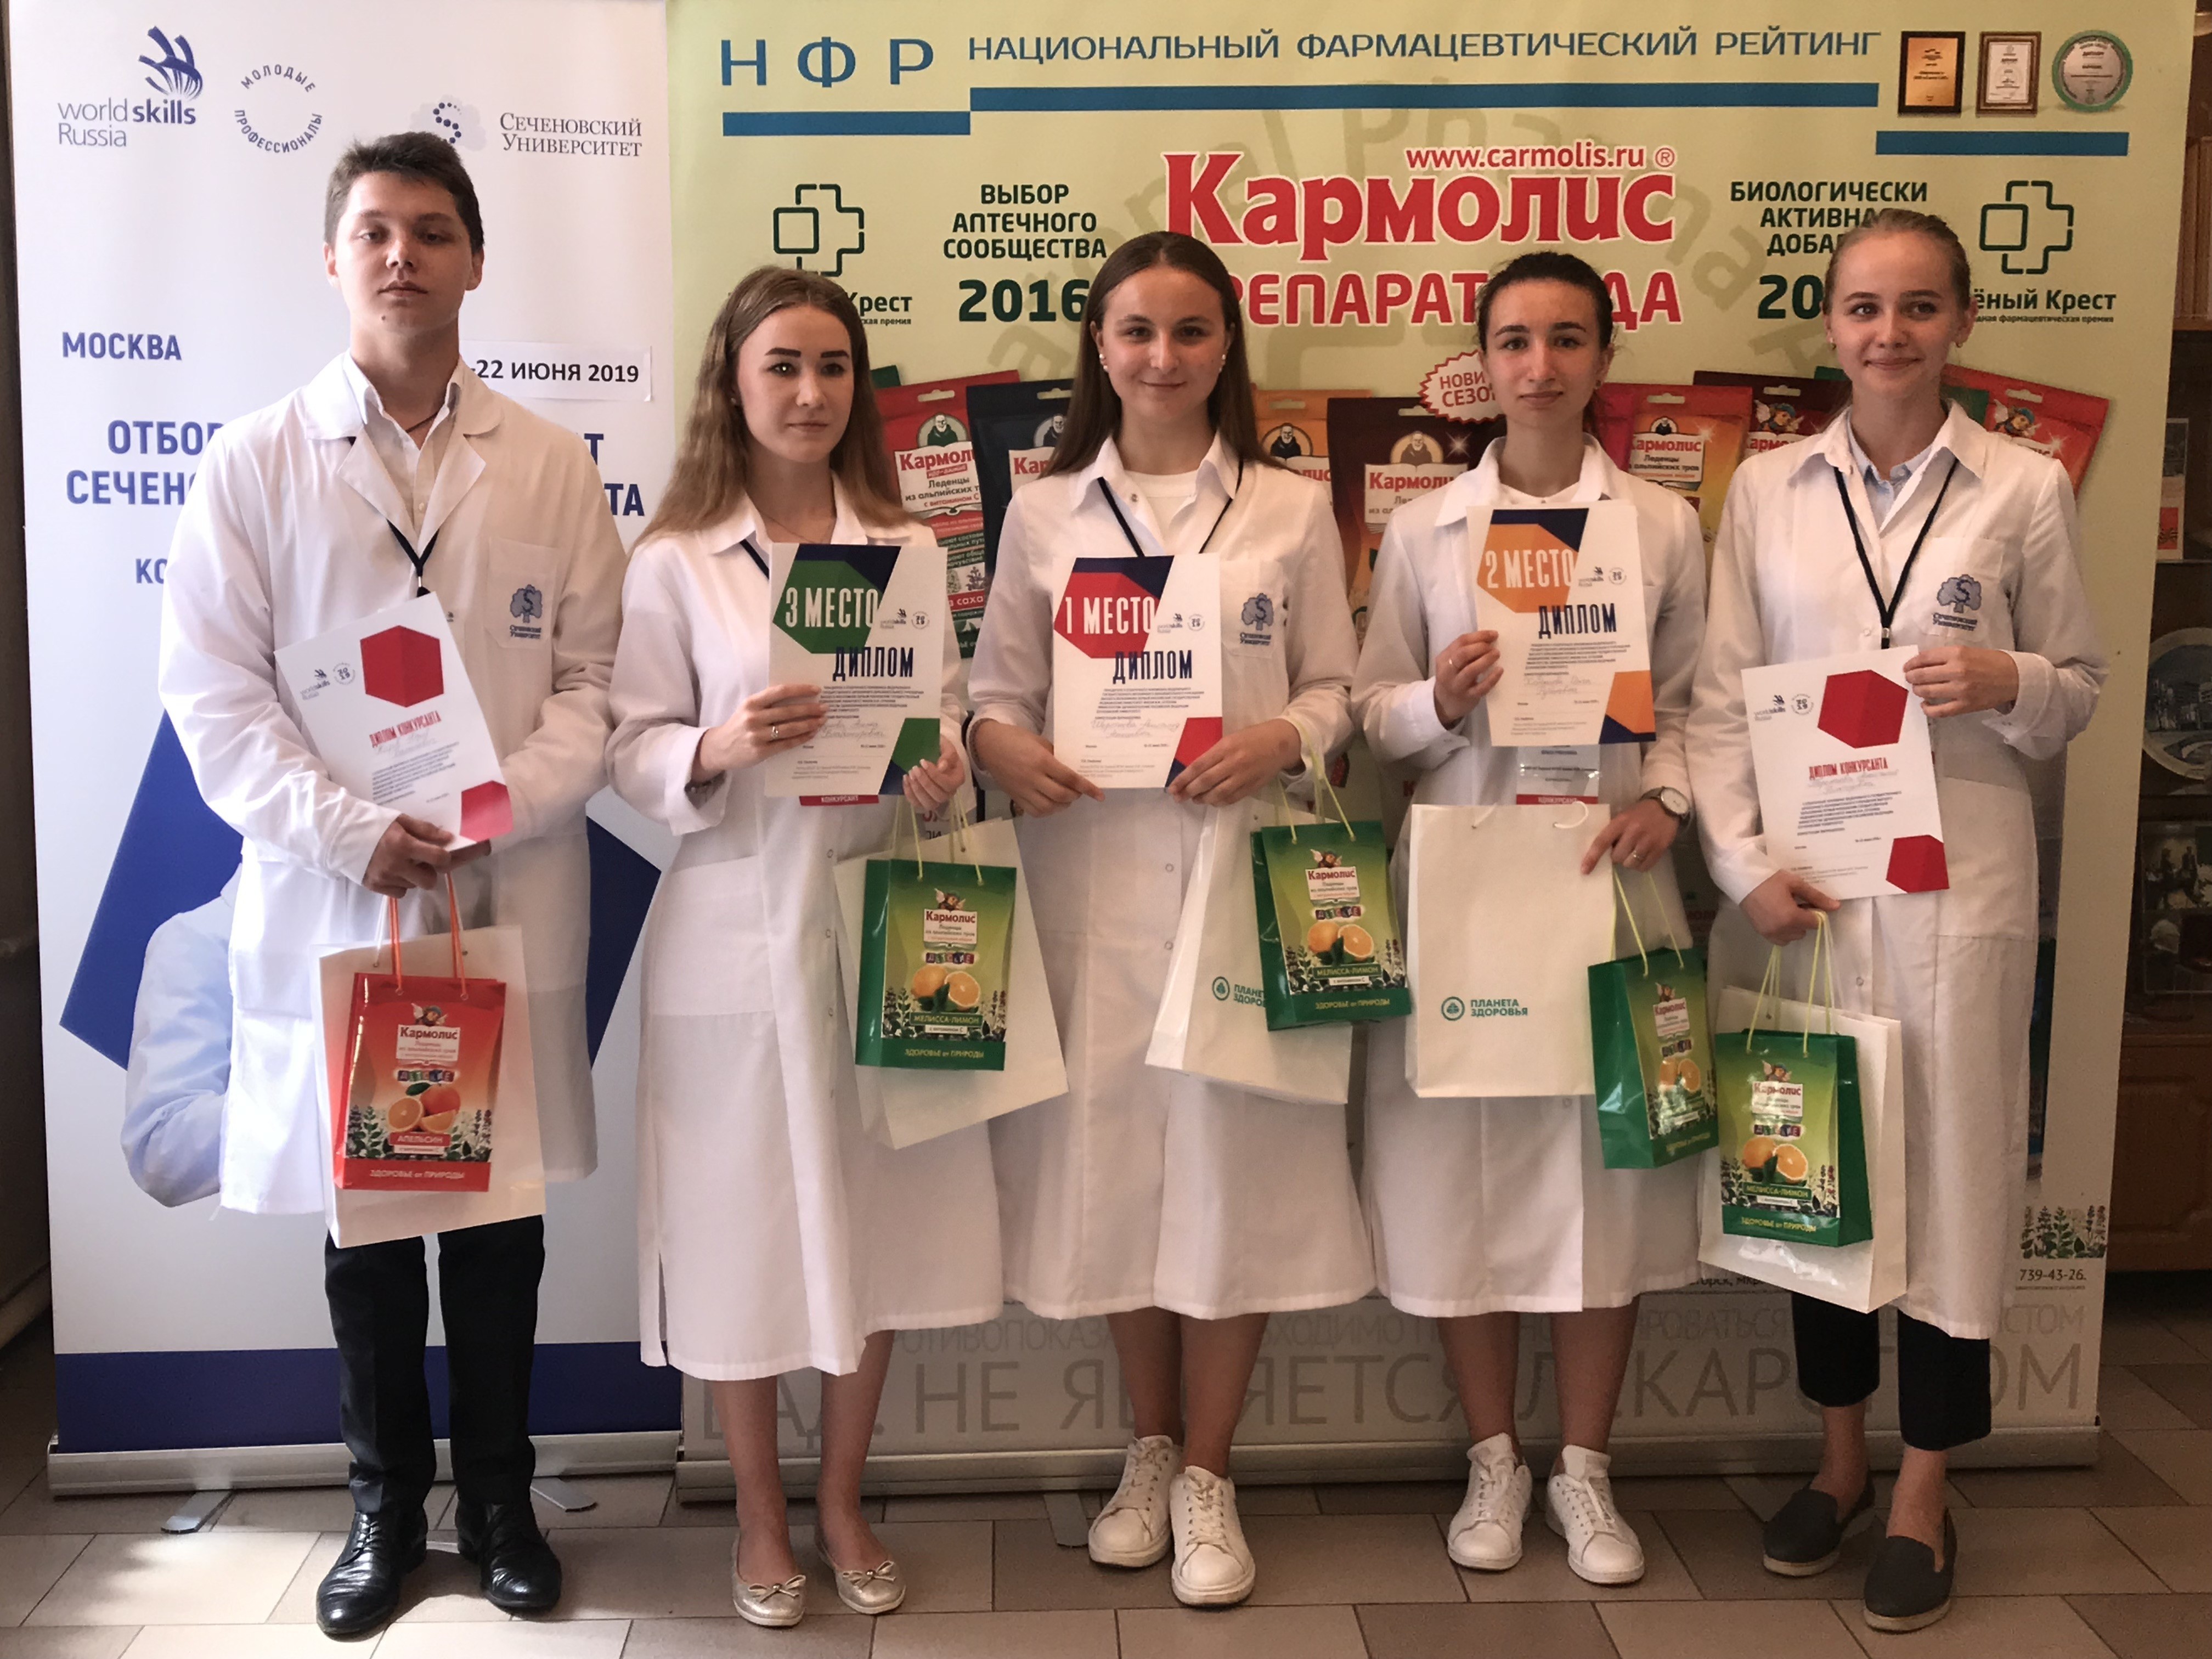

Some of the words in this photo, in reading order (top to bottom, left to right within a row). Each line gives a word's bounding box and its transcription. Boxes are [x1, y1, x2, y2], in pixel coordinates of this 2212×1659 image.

[969, 29, 1280, 64] НАЦИОНАЛЬНЫЙ
[1296, 25, 1697, 61] ФАРМАЦЕВТИЧЕСКИЙ
[1715, 25, 1881, 56] РЕЙТИНГ
[240, 64, 315, 93] МОЛОДЫЕ
[58, 123, 127, 147] Russia
[234, 110, 323, 153] ПРОФЕССИОНАЛЫ
[1406, 142, 1644, 169] www.carmolis.ru
[980, 184, 1069, 204] ВЫБОР
[1730, 181, 1928, 202] БИОЛОГИЧЕСКИ
[1163, 152, 1675, 262] Кармолис
[952, 212, 1097, 233] АПТЕЧНОГО
[943, 238, 1107, 261] СООБЩЕСТВА
[1767, 233, 1842, 257] ДОБА
[958, 279, 1090, 323] 2016
[1757, 275, 1824, 319] 20
[2046, 290, 2117, 314] Крест
[63, 332, 182, 361] МОСКВА
[511, 362, 581, 381] ИЮНЯ
[588, 364, 639, 382] 2019
[1439, 371, 1485, 391] НОВИ
[1632, 440, 1702, 453] армолис
[66, 470, 198, 505] СЕЧЕН
[929, 477, 970, 488] Леденцы
[1486, 551, 1500, 589] 2
[1504, 549, 1577, 589] МЕСТО
[804, 587, 879, 628] МЕСТО
[957, 596, 984, 605] саха
[1083, 596, 1155, 634] МЕСТО
[1538, 602, 1617, 639] ДИПЛОМ
[832, 646, 914, 681] ДИПЛОМ
[1113, 650, 1192, 684] ДИПЛОМ
[1308, 871, 1356, 881] Кармолис
[926, 911, 975, 923] Кармолис
[1234, 994, 1263, 1006] ЗДОРО
[1471, 999, 1519, 1007] ПЛАНЕТА
[1471, 1008, 1528, 1017] ЗДОРОВЬЯ
[400, 1027, 458, 1039] Кармолис
[915, 1361, 1022, 1434] НЕ
